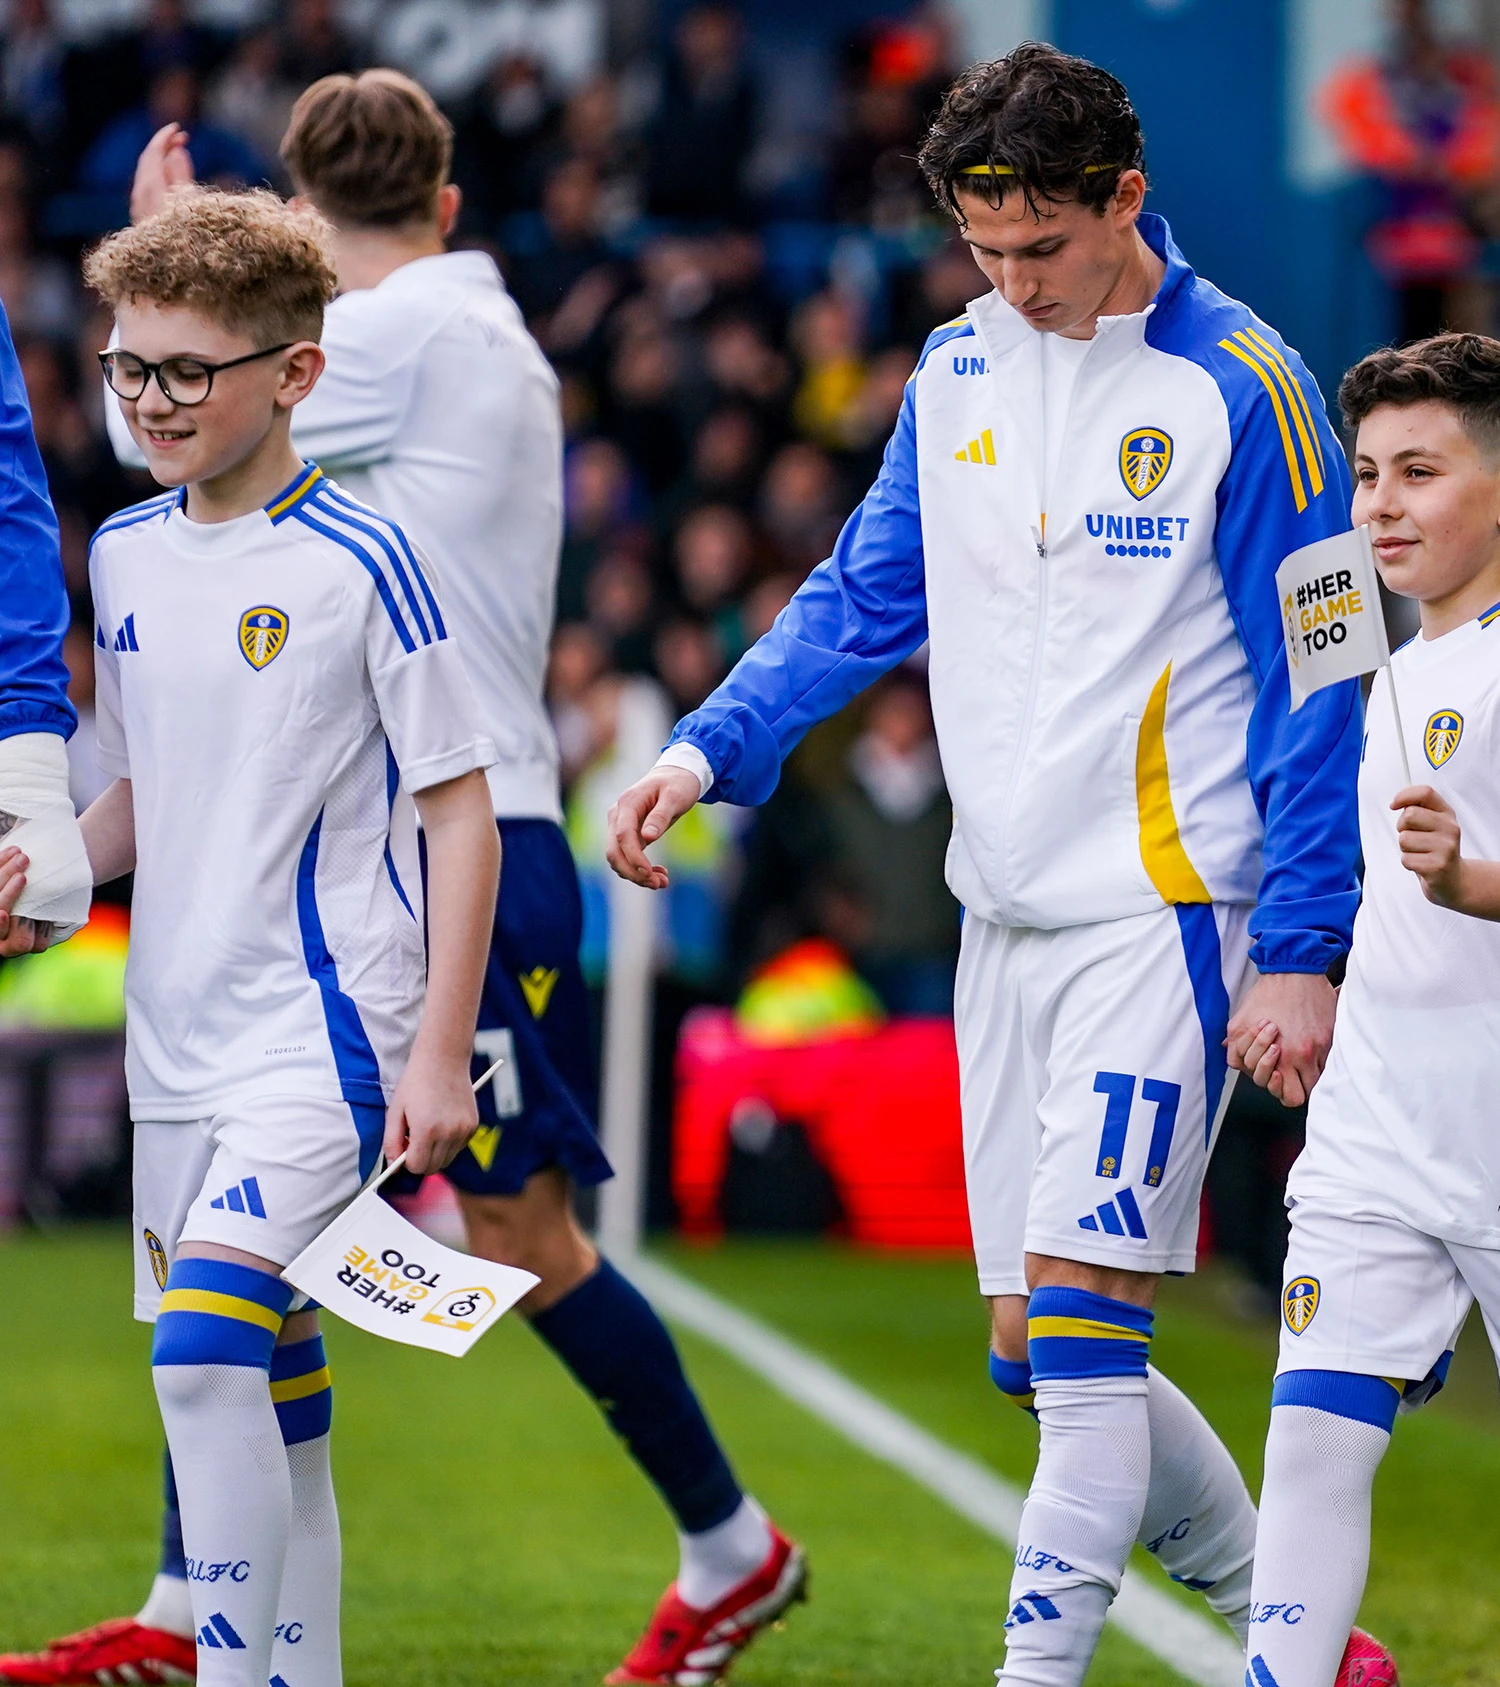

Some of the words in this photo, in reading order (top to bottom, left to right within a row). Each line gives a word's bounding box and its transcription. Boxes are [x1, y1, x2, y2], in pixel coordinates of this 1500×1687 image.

[953, 357, 990, 376] UN
[1086, 514, 1189, 541] UNIBET
[1297, 569, 1353, 609] #HER
[1300, 590, 1363, 632] GAME
[1303, 621, 1347, 656] TOO
[1093, 1071, 1182, 1188] 11
[343, 1244, 429, 1301] GAME
[381, 1249, 441, 1288] TOO
[336, 1264, 416, 1315] #HER
